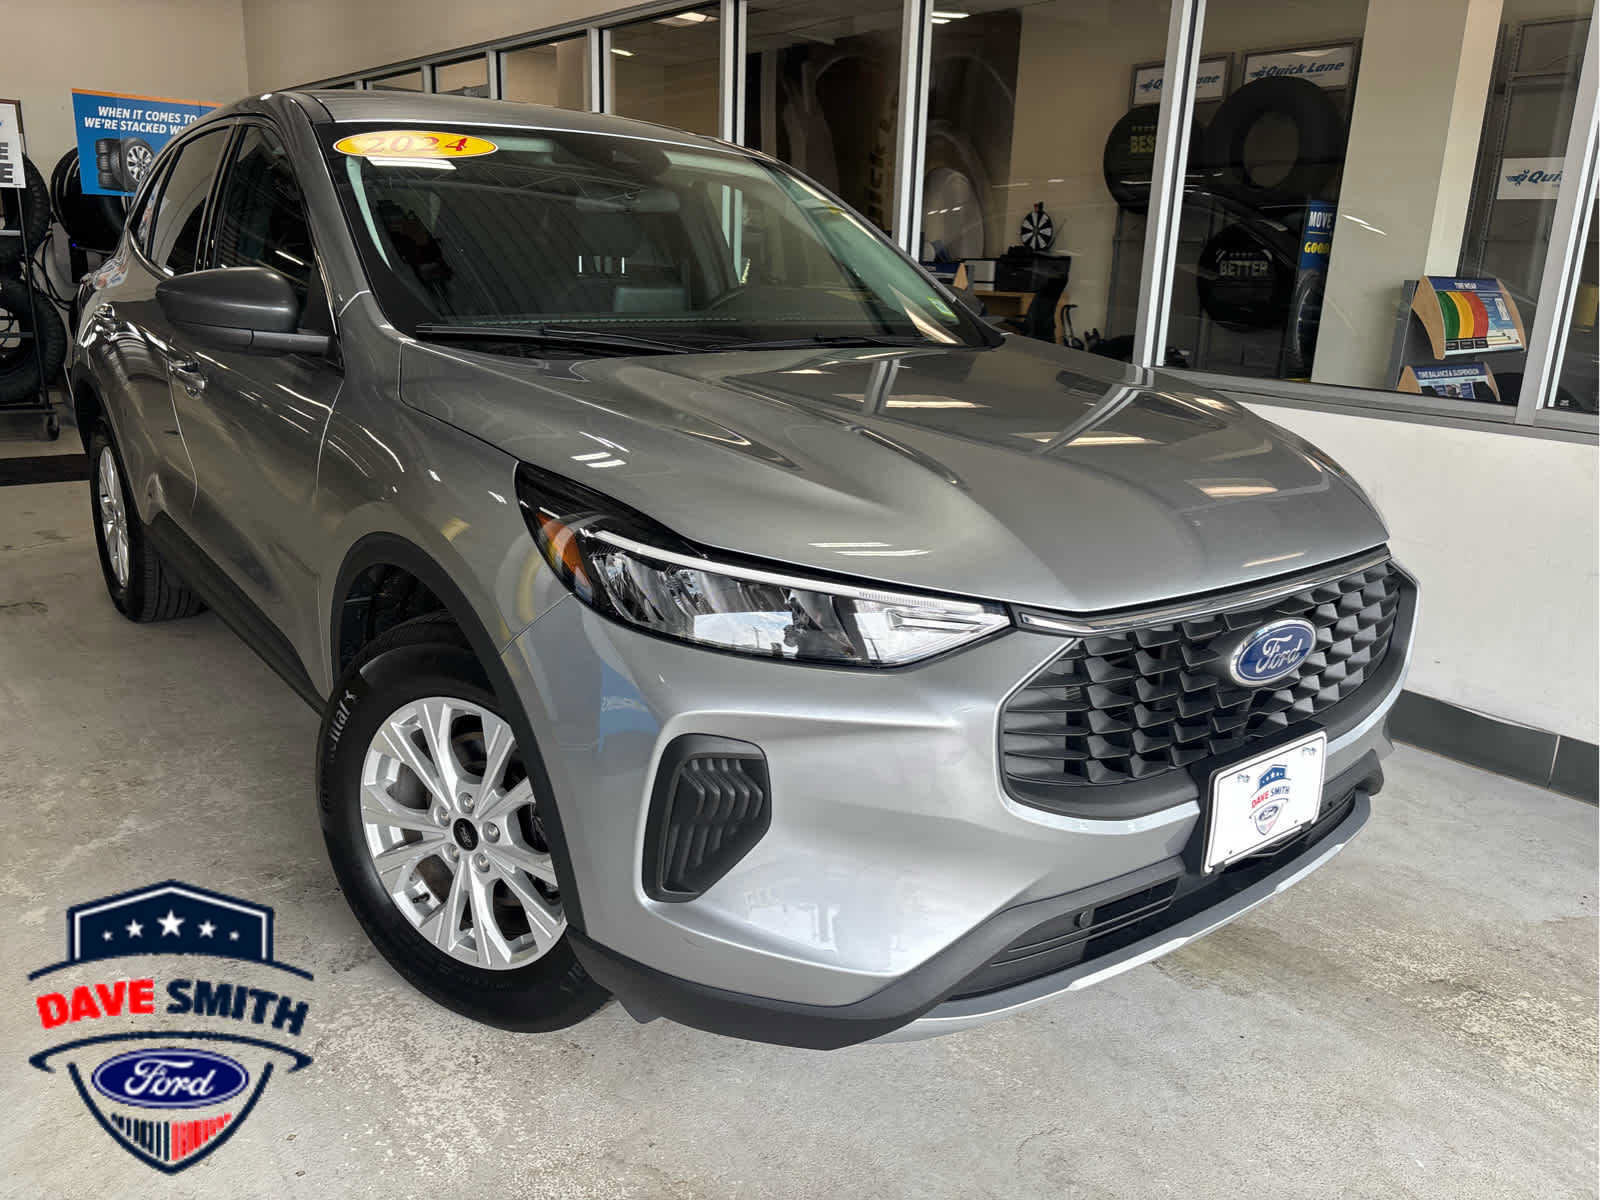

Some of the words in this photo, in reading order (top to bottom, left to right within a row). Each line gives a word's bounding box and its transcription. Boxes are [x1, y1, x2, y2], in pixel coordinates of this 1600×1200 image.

[1307, 61, 1345, 74] Lane
[98, 106, 130, 119] WHEN
[133, 109, 143, 120] IT
[145, 111, 181, 123] COMES
[84, 117, 118, 129] WE'RE
[120, 121, 167, 134] STACKED
[364, 136, 468, 153] 2024
[1528, 170, 1563, 184] Qui
[1219, 261, 1268, 277] BETTER
[1256, 635, 1303, 673] Ford
[1251, 791, 1270, 809] DAVE
[1270, 786, 1290, 797] SMITH
